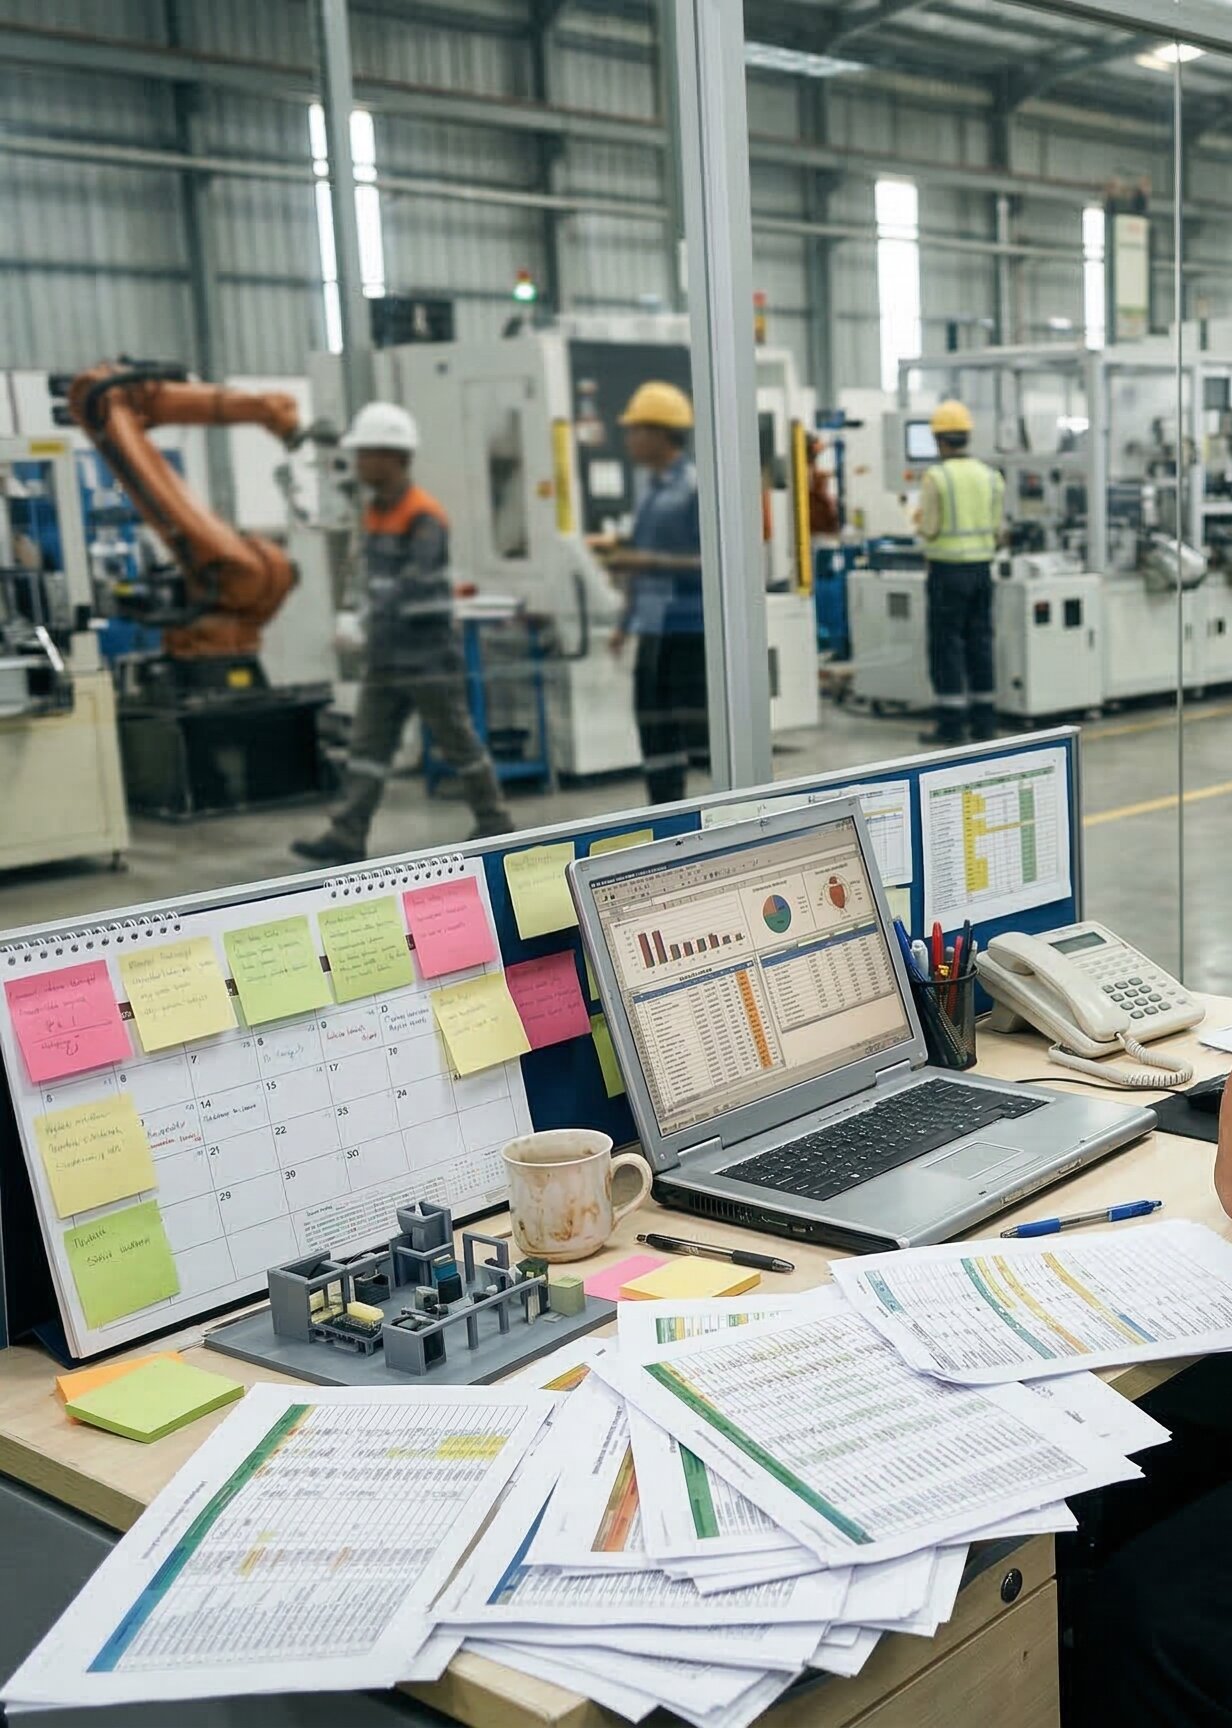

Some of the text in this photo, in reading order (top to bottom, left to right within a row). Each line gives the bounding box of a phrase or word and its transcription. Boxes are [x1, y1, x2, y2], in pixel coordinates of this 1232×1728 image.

[396, 1089, 407, 1099] 24
[200, 1099, 211, 1109] 14
[274, 1125, 287, 1136] 22
[209, 1145, 220, 1156] 21
[219, 1190, 232, 1202] 29
